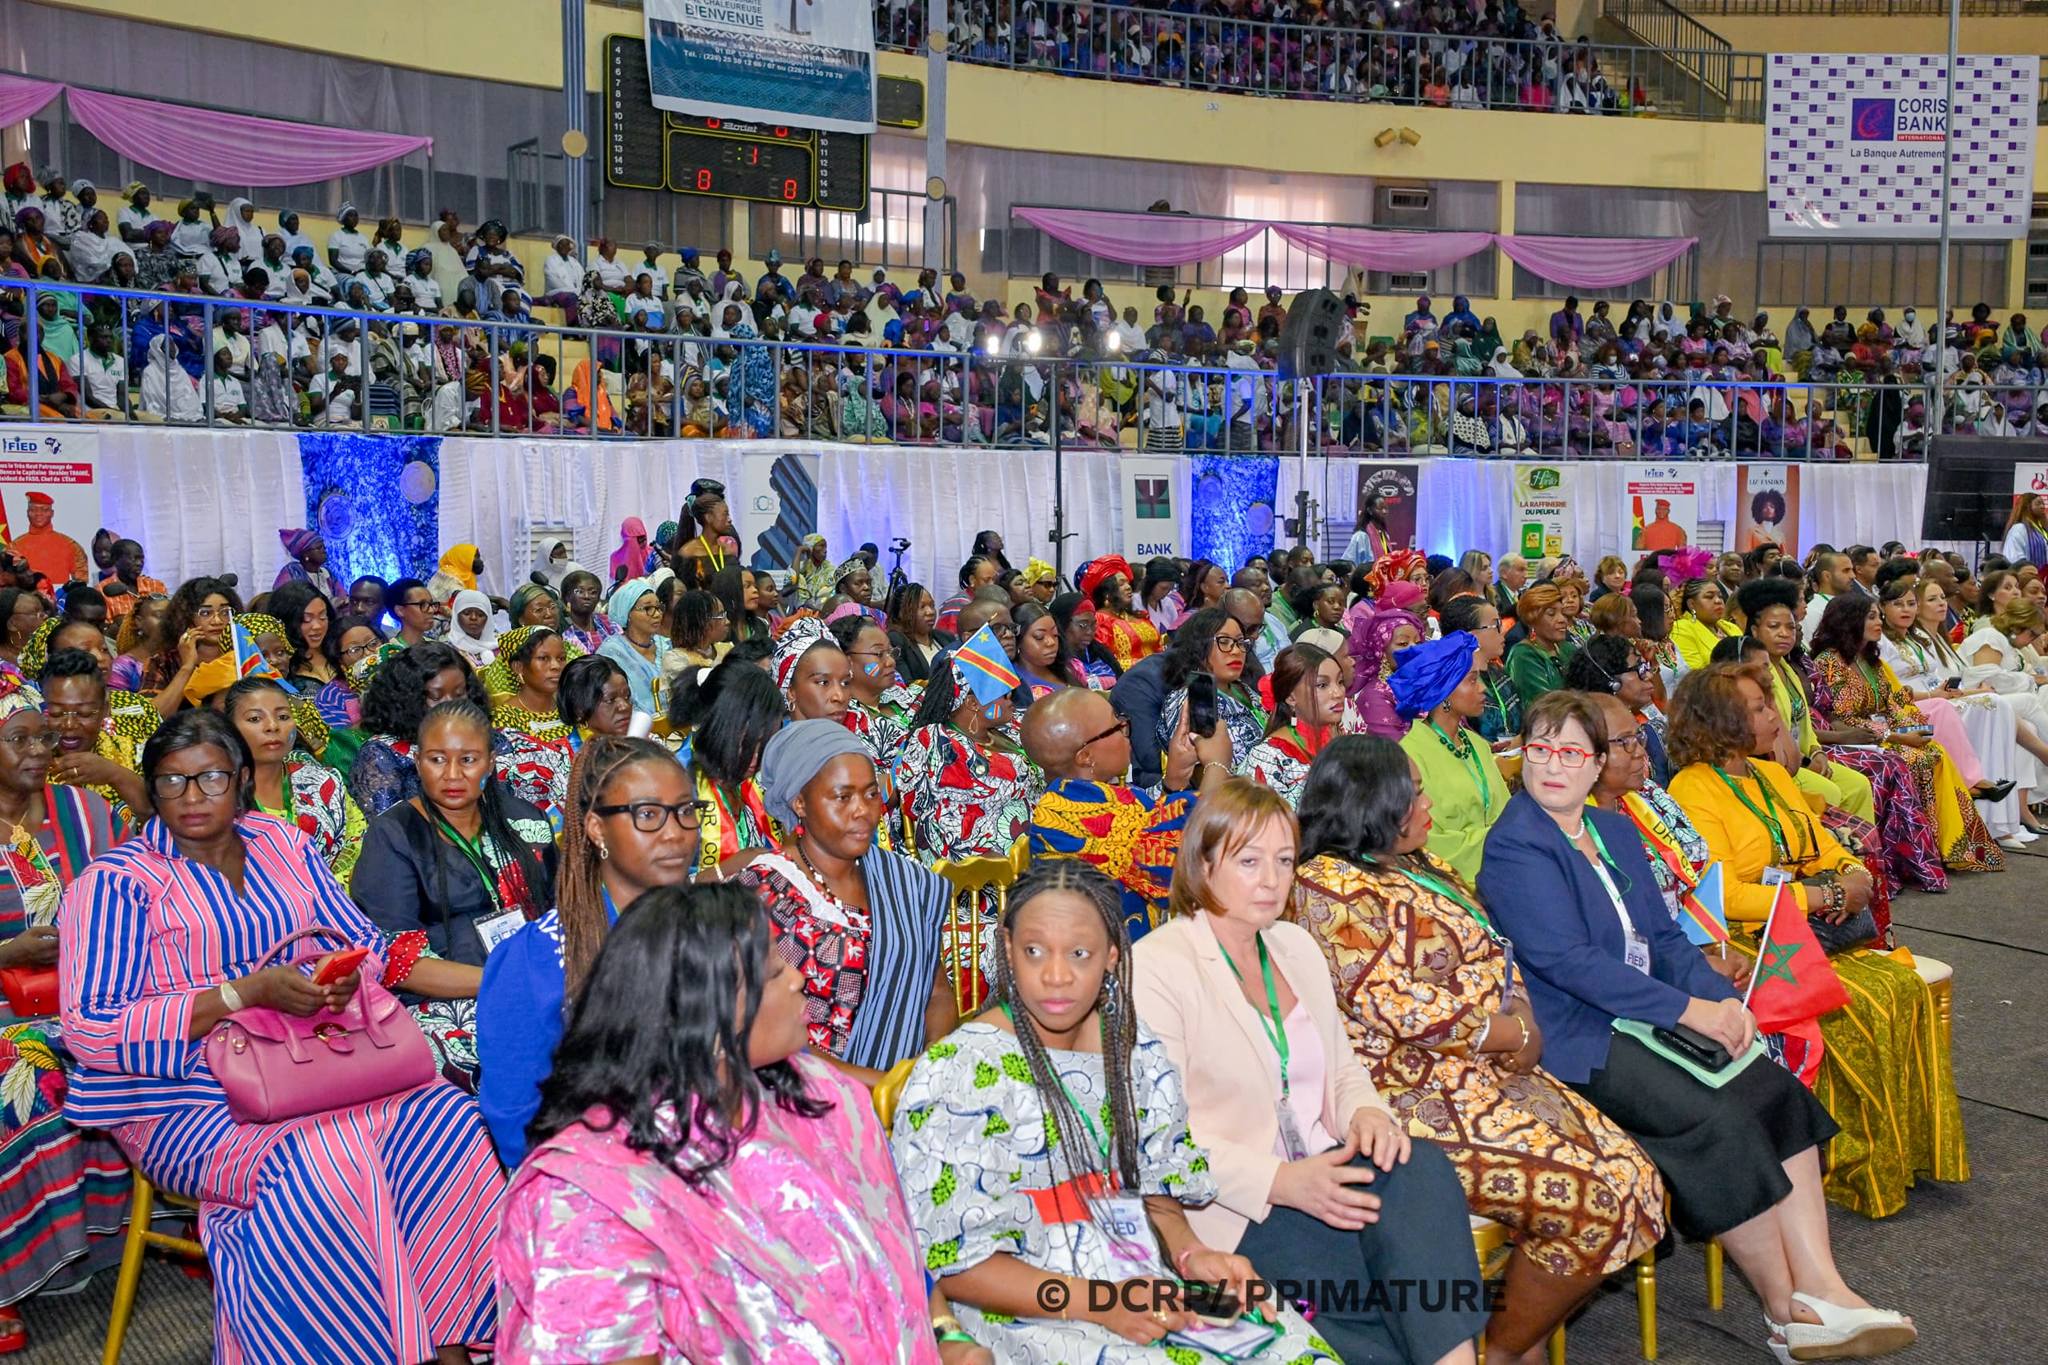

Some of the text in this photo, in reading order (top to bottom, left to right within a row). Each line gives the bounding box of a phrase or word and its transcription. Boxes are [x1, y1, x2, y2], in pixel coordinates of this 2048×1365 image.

[685, 3, 764, 27] BIENVENUE
[615, 46, 621, 54] 4
[615, 57, 621, 65] 5
[615, 68, 621, 76] 6
[615, 90, 621, 98] 8
[1898, 98, 1948, 114] CORIS
[614, 112, 623, 120] 10
[614, 123, 623, 131] 11
[1897, 116, 1946, 131] BANK
[614, 134, 623, 142] 12
[820, 138, 828, 146] 10
[614, 145, 623, 153] 13
[820, 149, 828, 157] 11
[1850, 148, 1945, 159] La Banque Autrement
[614, 156, 623, 164] 14
[820, 159, 828, 167] 12
[614, 167, 623, 175] 15
[820, 169, 828, 177] 13
[820, 179, 828, 187] 14
[820, 189, 828, 197] 15
[1137, 543, 1173, 555] BANK
